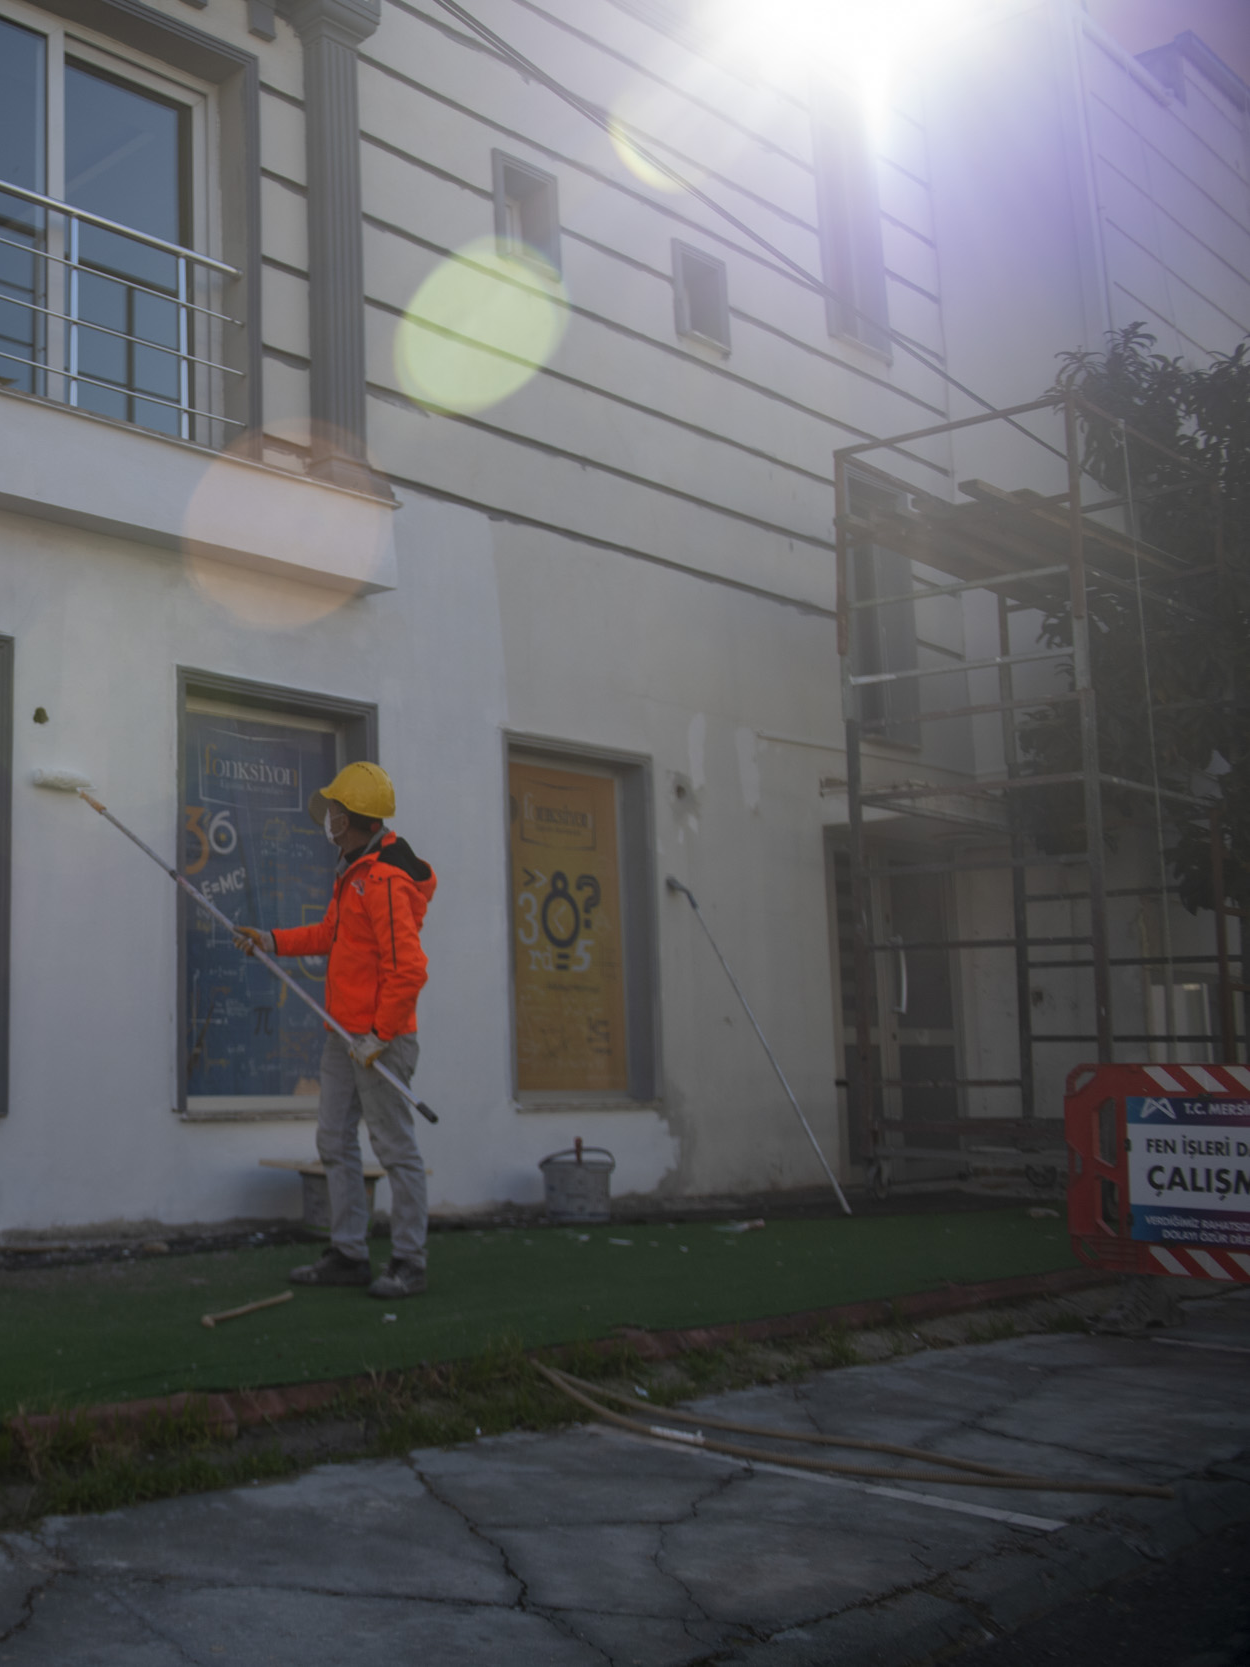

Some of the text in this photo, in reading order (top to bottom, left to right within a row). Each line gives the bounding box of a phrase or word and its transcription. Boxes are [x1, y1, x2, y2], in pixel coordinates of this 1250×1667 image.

[205, 743, 298, 787] fonksiyon
[1146, 1138, 1177, 1155] FEN
[1181, 1134, 1231, 1159] İŞLERİ
